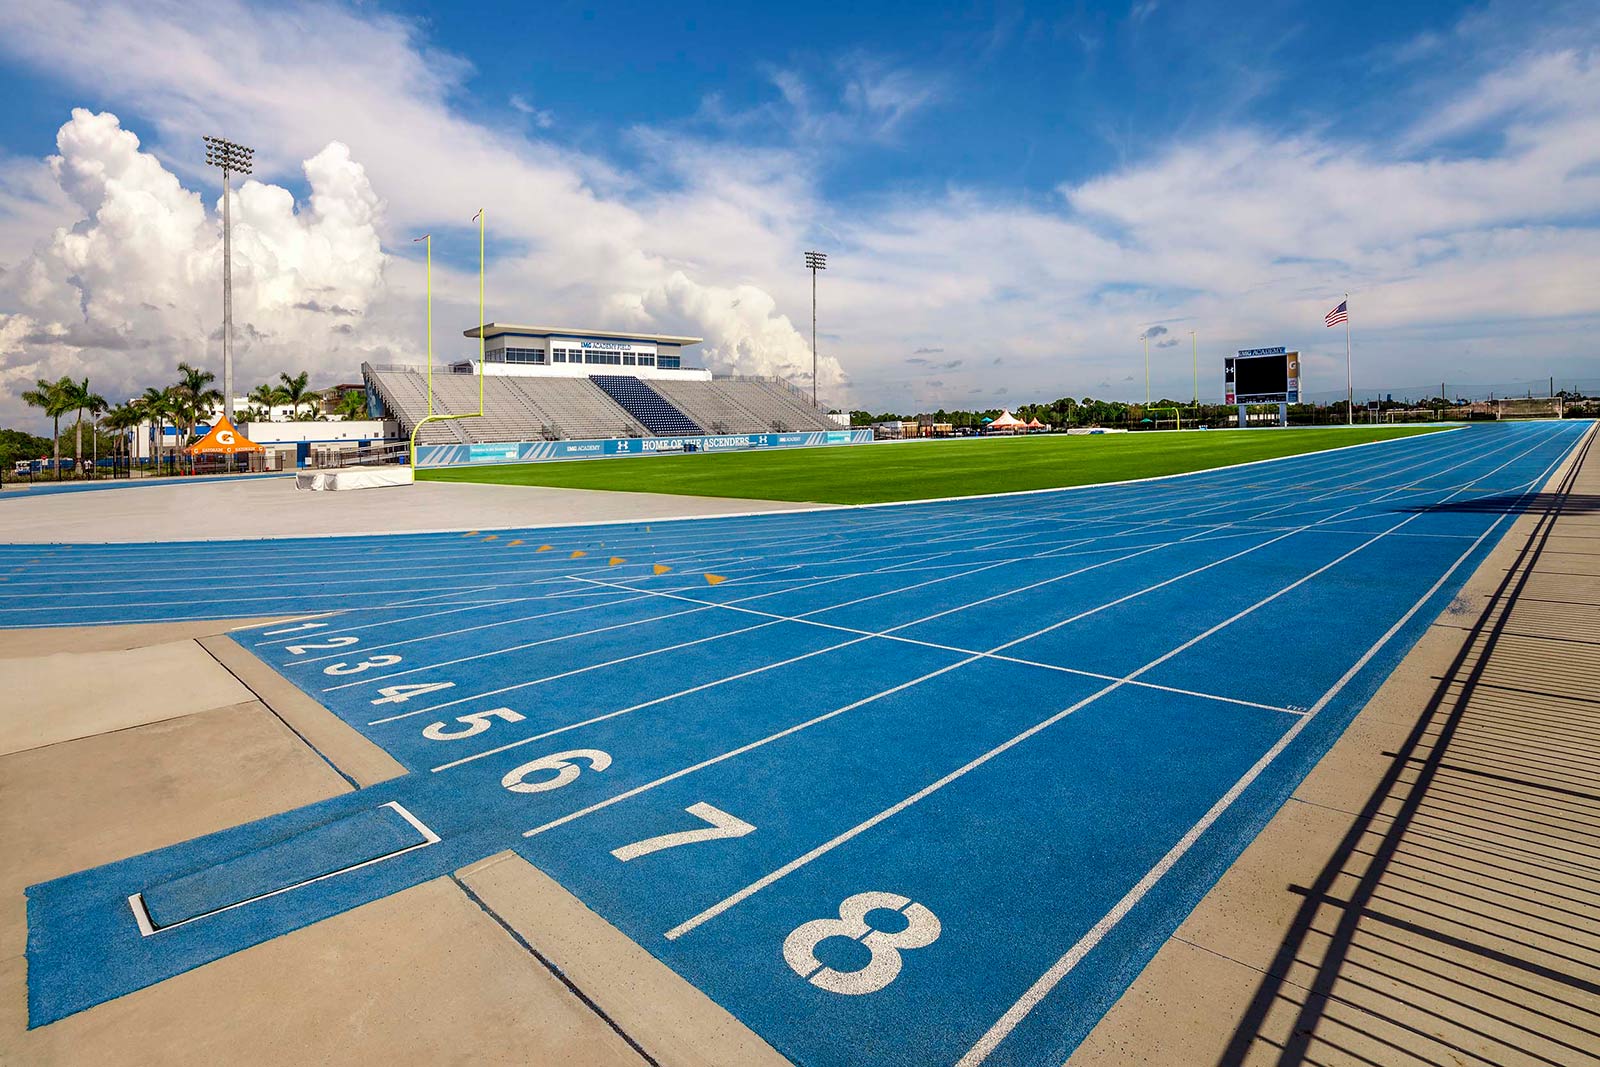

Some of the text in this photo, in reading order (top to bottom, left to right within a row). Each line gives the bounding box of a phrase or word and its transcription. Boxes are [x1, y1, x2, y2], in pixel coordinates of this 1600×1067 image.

[592, 342, 615, 350] ACADEMY
[1253, 347, 1283, 355] ACADEMY
[216, 430, 235, 445] G
[642, 437, 750, 450] HOME OF THE ASCENDERS
[263, 622, 328, 635] 1
[285, 637, 360, 655] 2
[323, 655, 402, 676] 3
[370, 682, 456, 705] 4
[422, 707, 527, 740] 5
[501, 749, 612, 793] 6
[609, 801, 757, 862] 7
[782, 891, 941, 995] 8
